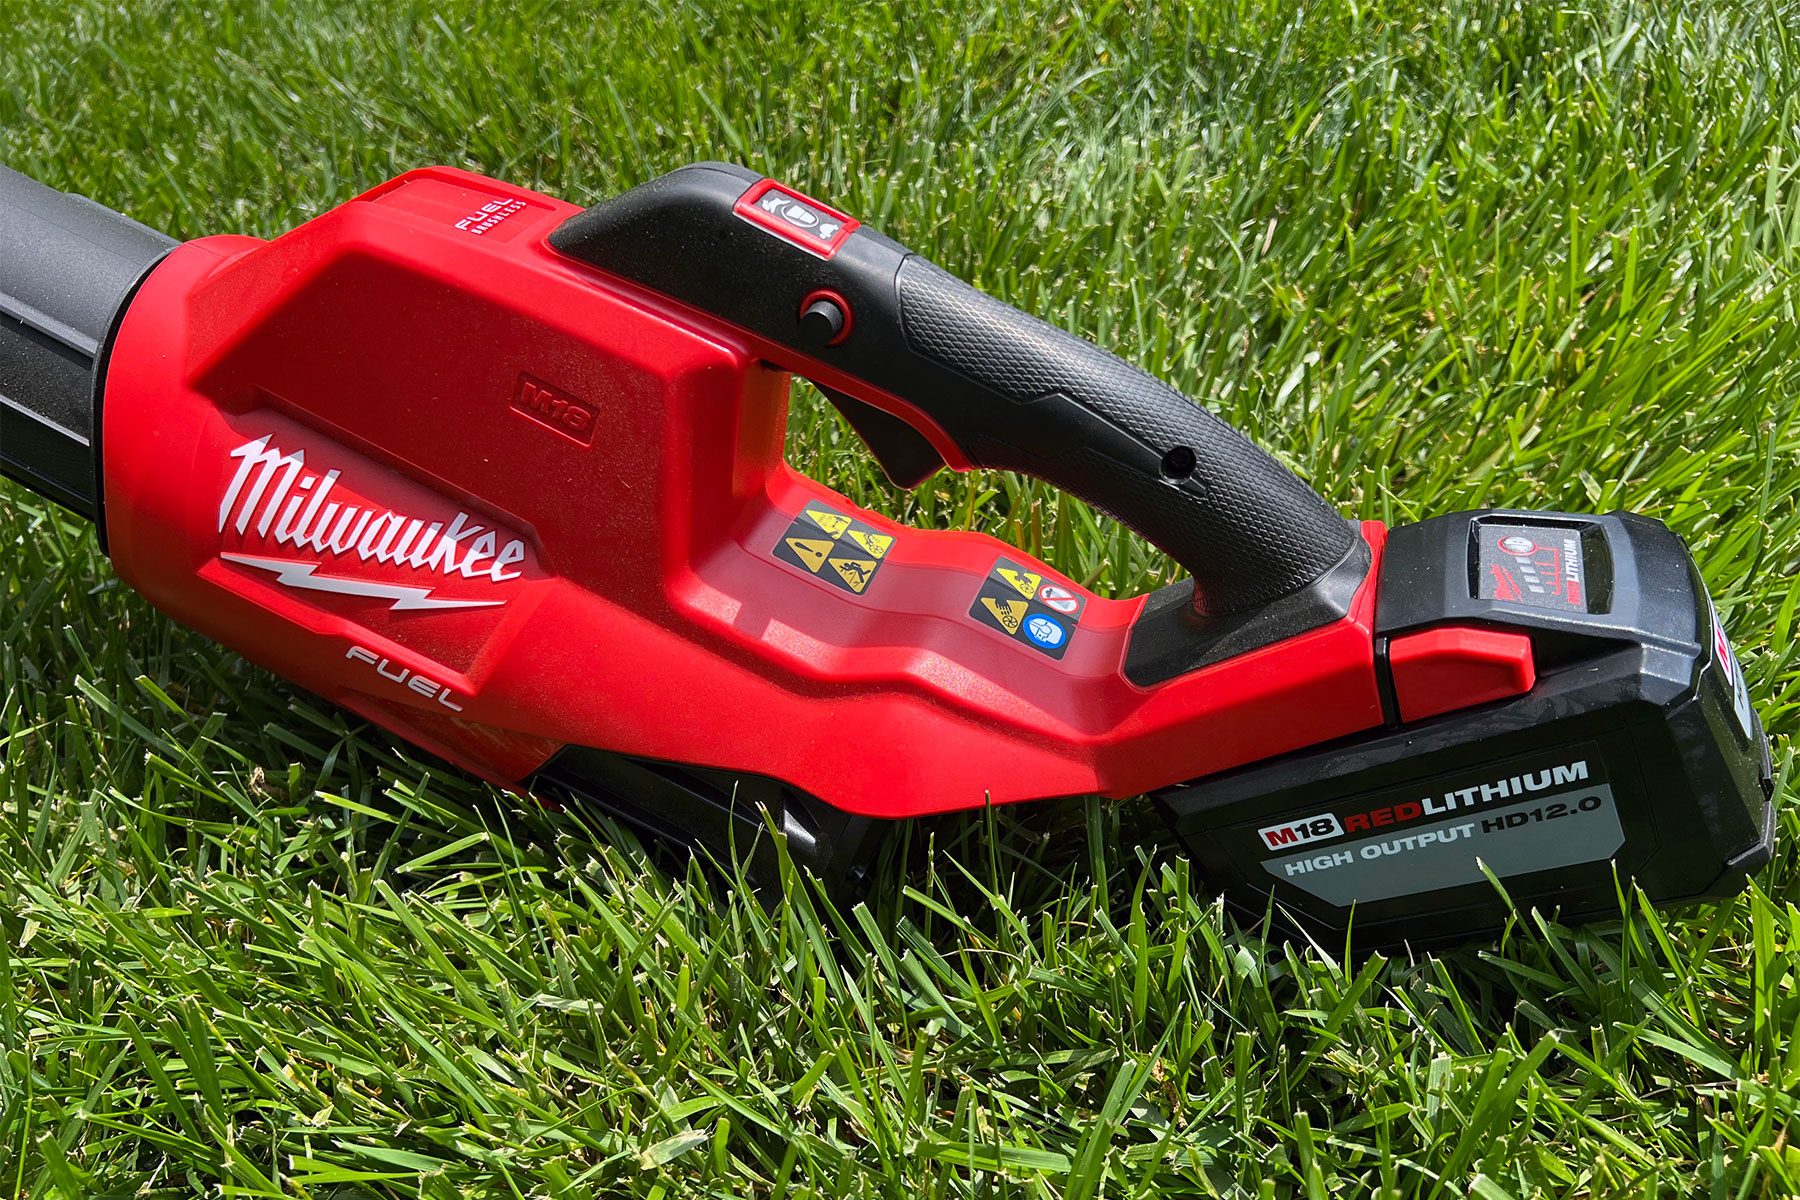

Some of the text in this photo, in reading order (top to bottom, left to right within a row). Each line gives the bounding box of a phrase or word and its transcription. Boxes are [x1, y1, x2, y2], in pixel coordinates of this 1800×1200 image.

[455, 198, 514, 231] FUEL
[470, 201, 527, 235] BRUSHLESS
[520, 382, 591, 431] M18
[218, 433, 526, 582] Milwaukee
[346, 645, 464, 712] FUEL
[1265, 817, 1336, 848] M18
[1285, 795, 1602, 877] HIGH OUTPUT HD12.0
